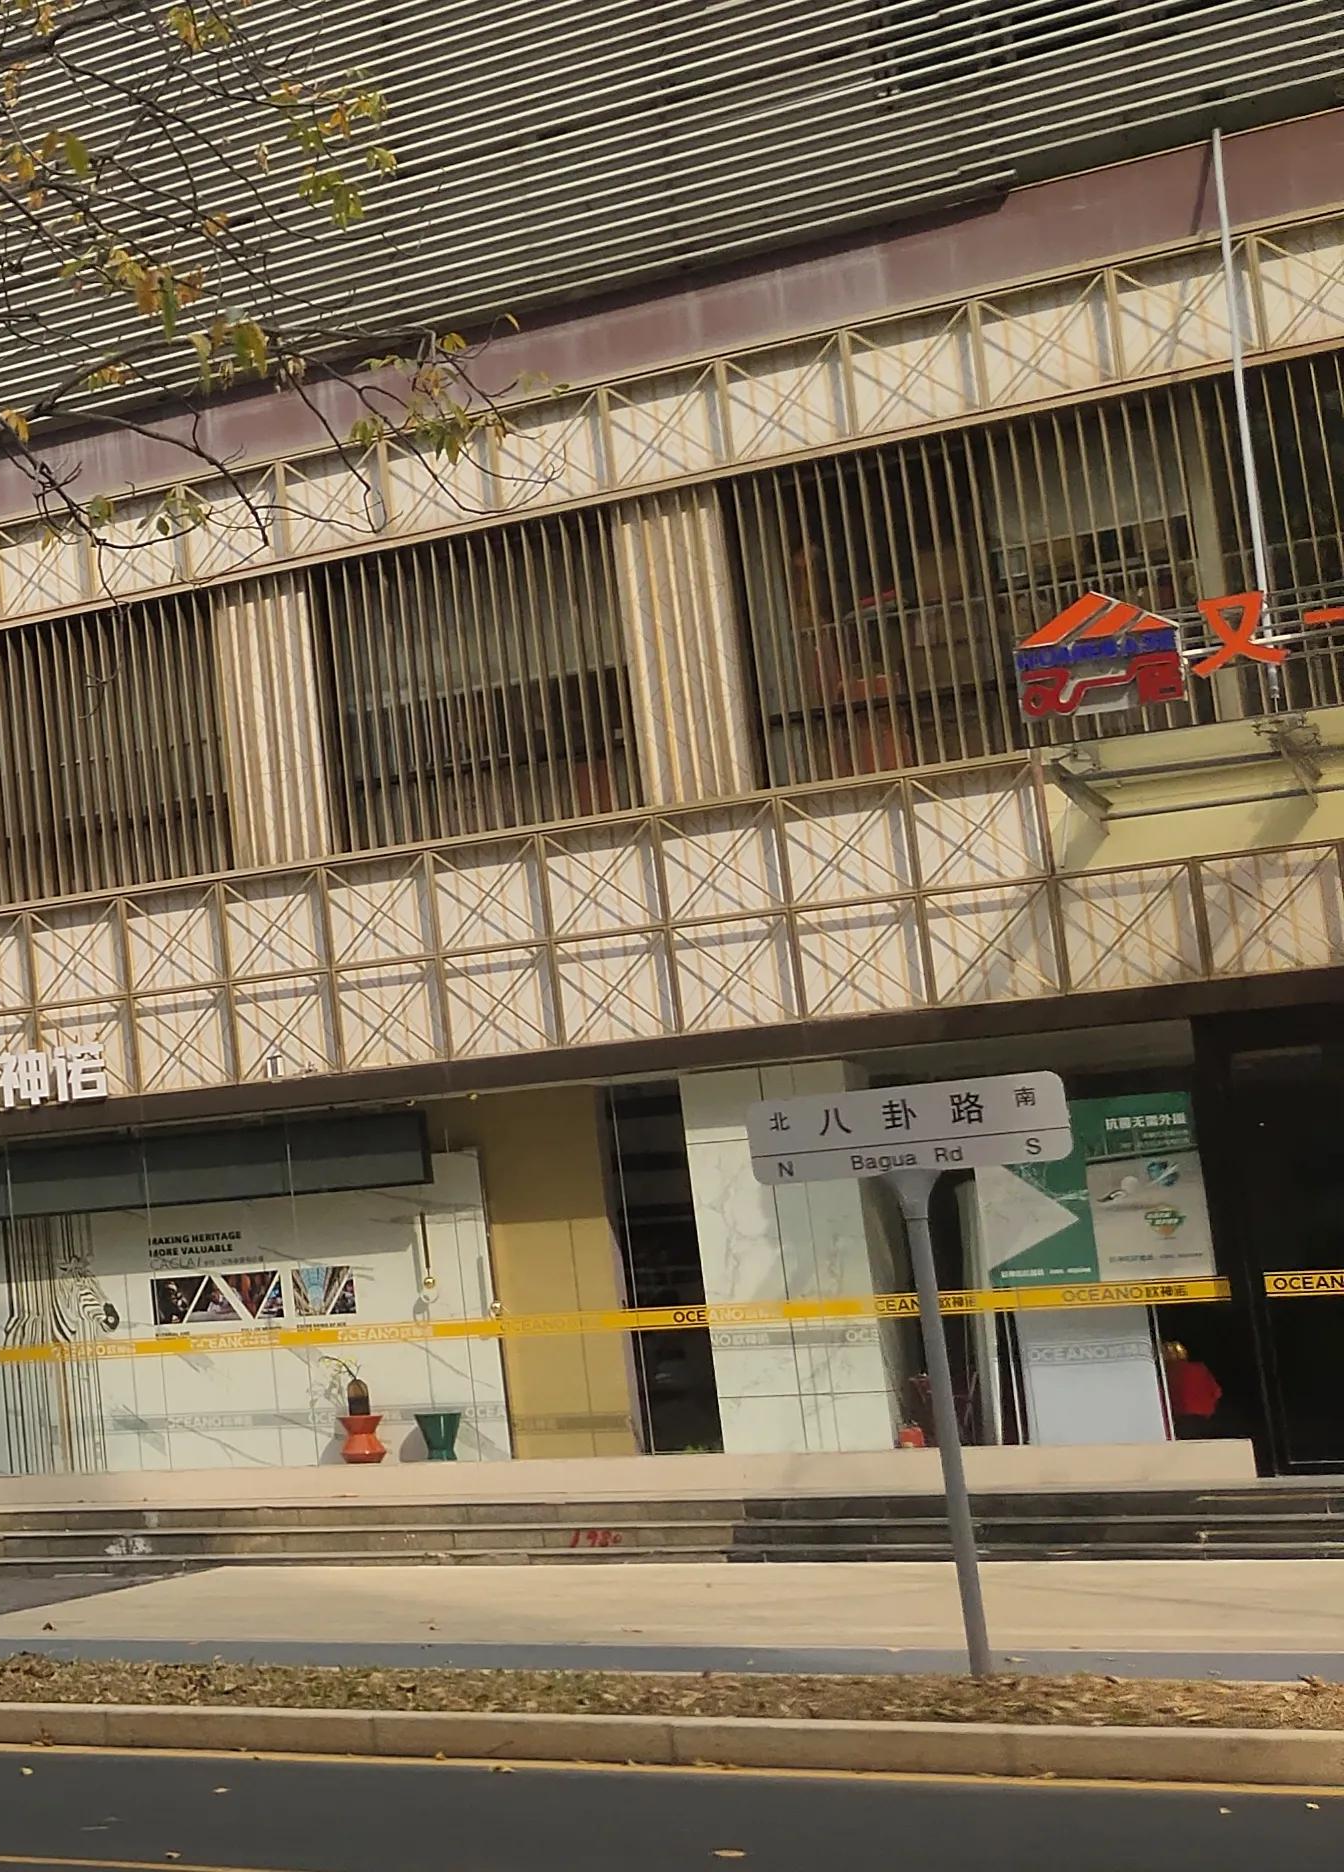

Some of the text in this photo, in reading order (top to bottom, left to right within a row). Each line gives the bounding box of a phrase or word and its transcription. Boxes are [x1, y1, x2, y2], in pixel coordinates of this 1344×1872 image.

[770, 1086, 1036, 1136] 北 八卦路 南
[778, 1137, 1042, 1177] N Bagua Rd S
[148, 1231, 241, 1246] MAKING HERITAGE
[149, 1244, 233, 1258] MORE VALUABLE
[1063, 1287, 1143, 1302] OCEANO
[874, 1298, 920, 1312] CEAN
[673, 1309, 744, 1323] OCEANO
